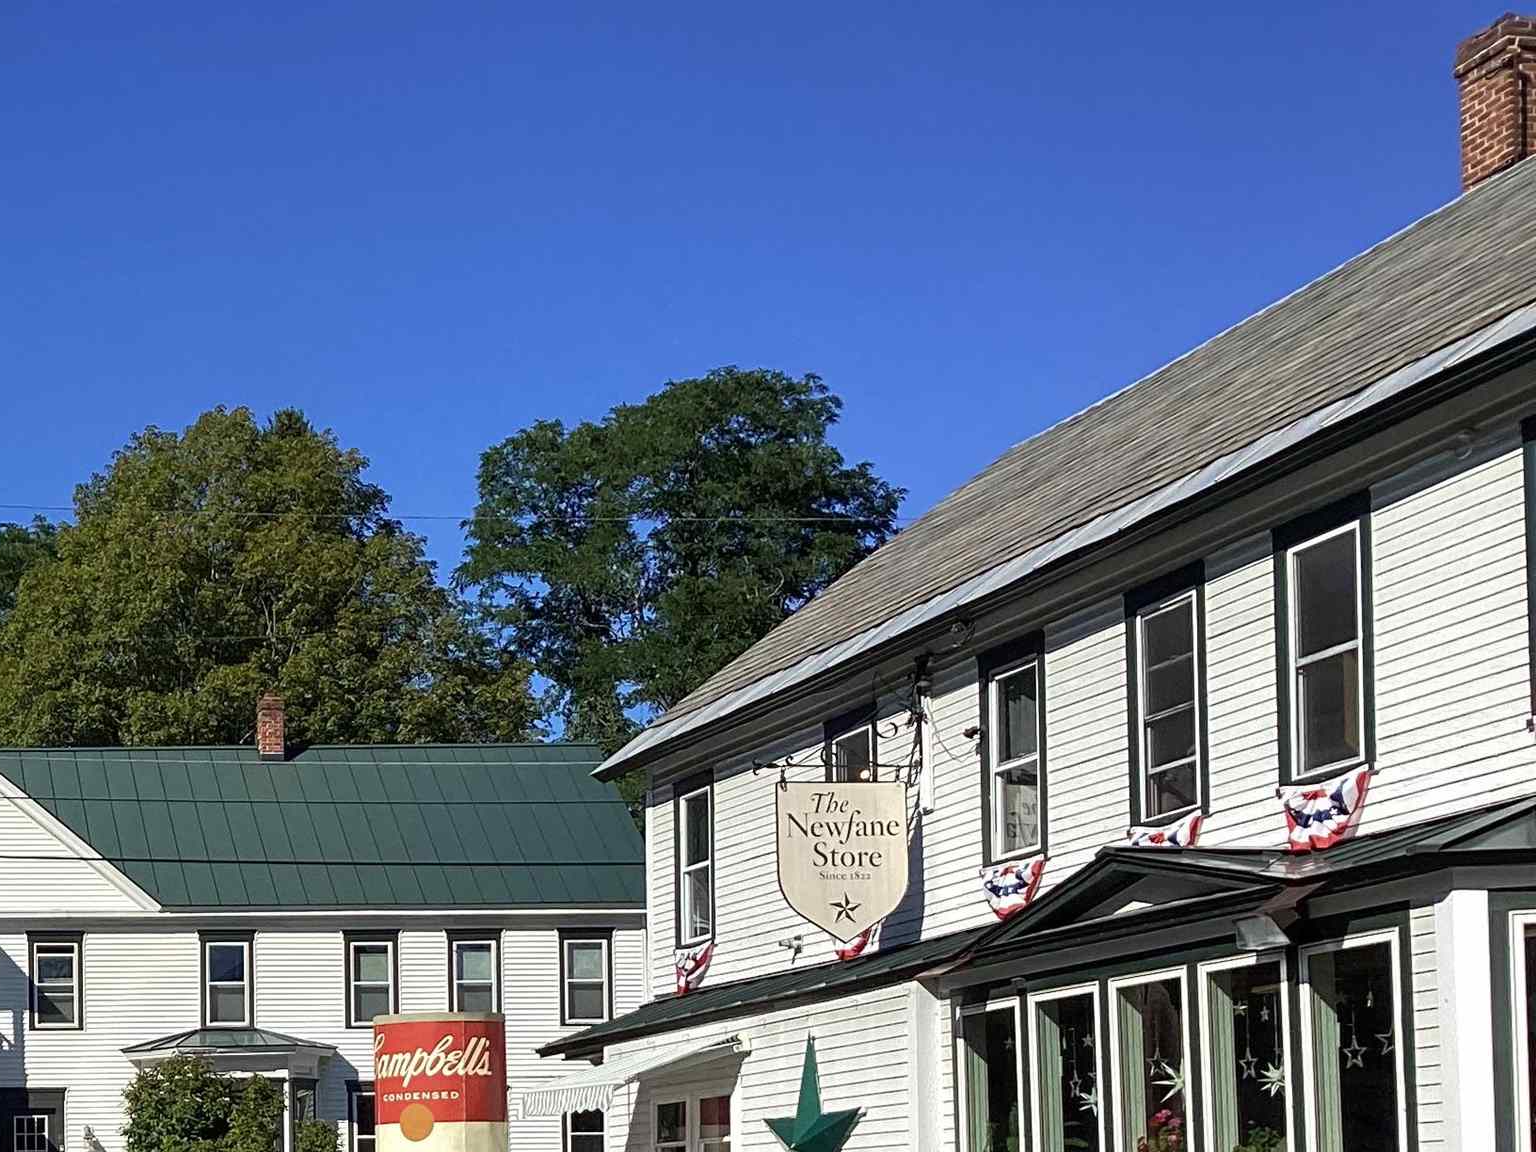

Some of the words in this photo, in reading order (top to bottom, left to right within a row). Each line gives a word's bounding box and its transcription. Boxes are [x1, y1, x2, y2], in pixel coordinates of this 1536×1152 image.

[812, 792, 849, 814] The
[787, 810, 901, 845] Newfane
[812, 841, 883, 867] Store
[819, 871, 848, 881] Since
[382, 1090, 460, 1103] CONDENSED
